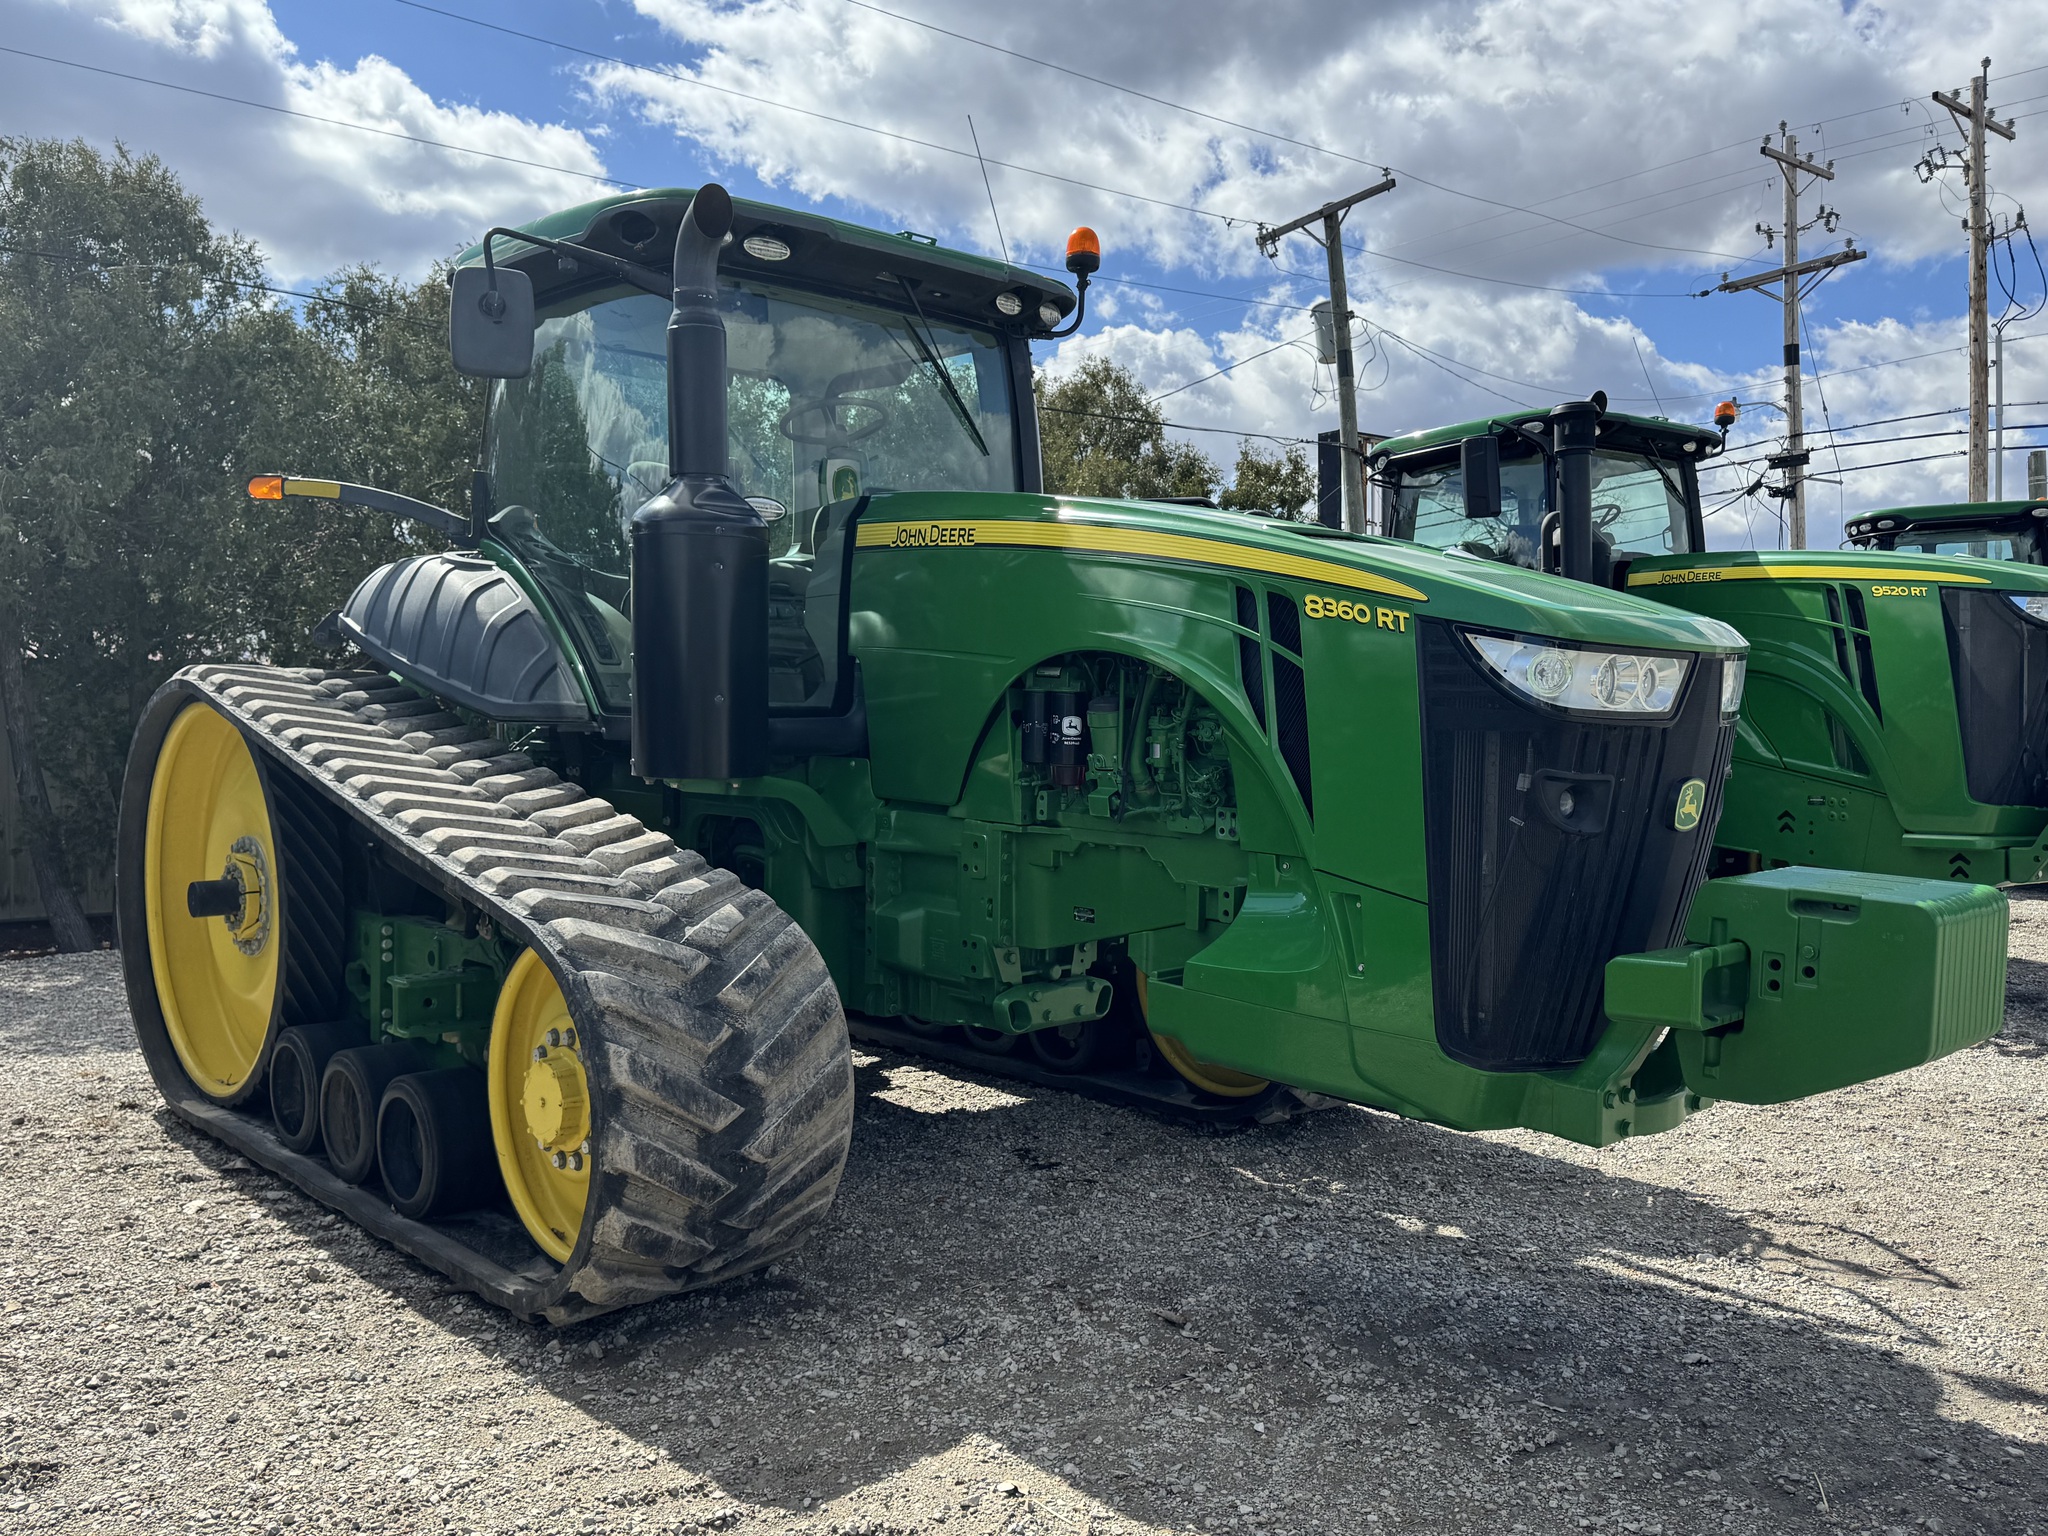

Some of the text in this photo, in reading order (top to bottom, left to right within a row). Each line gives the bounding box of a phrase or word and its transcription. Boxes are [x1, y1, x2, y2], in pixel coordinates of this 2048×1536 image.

[890, 524, 976, 546] JOHN DEERE
[1658, 571, 1722, 583] JOHN DEERE
[1871, 585, 1928, 597] 9520 RT
[1304, 593, 1410, 633] 8360 RT
